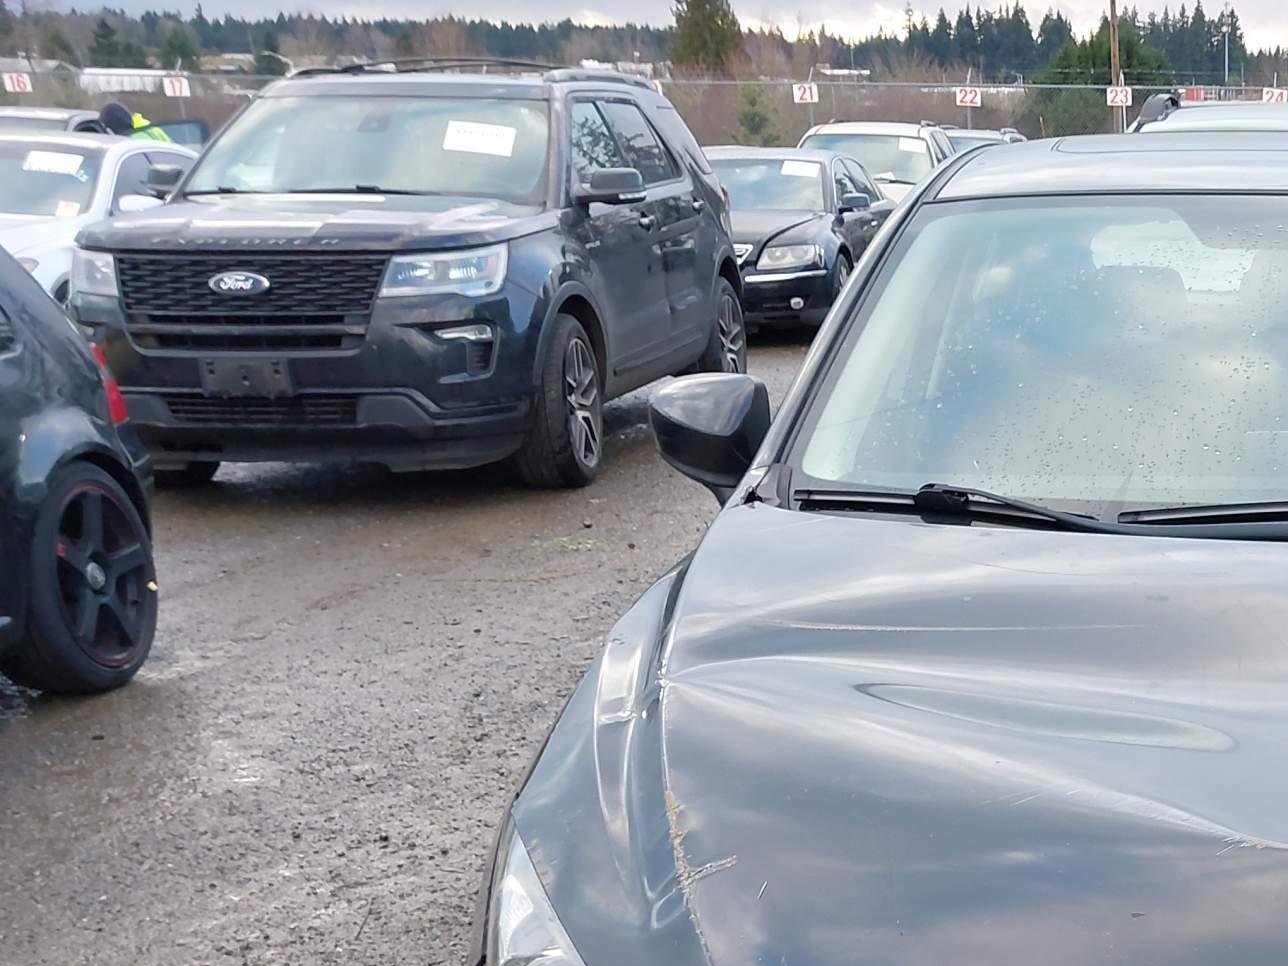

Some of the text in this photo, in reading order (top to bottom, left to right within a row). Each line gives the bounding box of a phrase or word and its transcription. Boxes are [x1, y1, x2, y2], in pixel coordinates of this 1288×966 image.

[8, 73, 27, 91] 16
[169, 79, 184, 97] 17
[798, 84, 816, 101] 21
[958, 88, 979, 105] 22
[1109, 88, 1129, 104] 23
